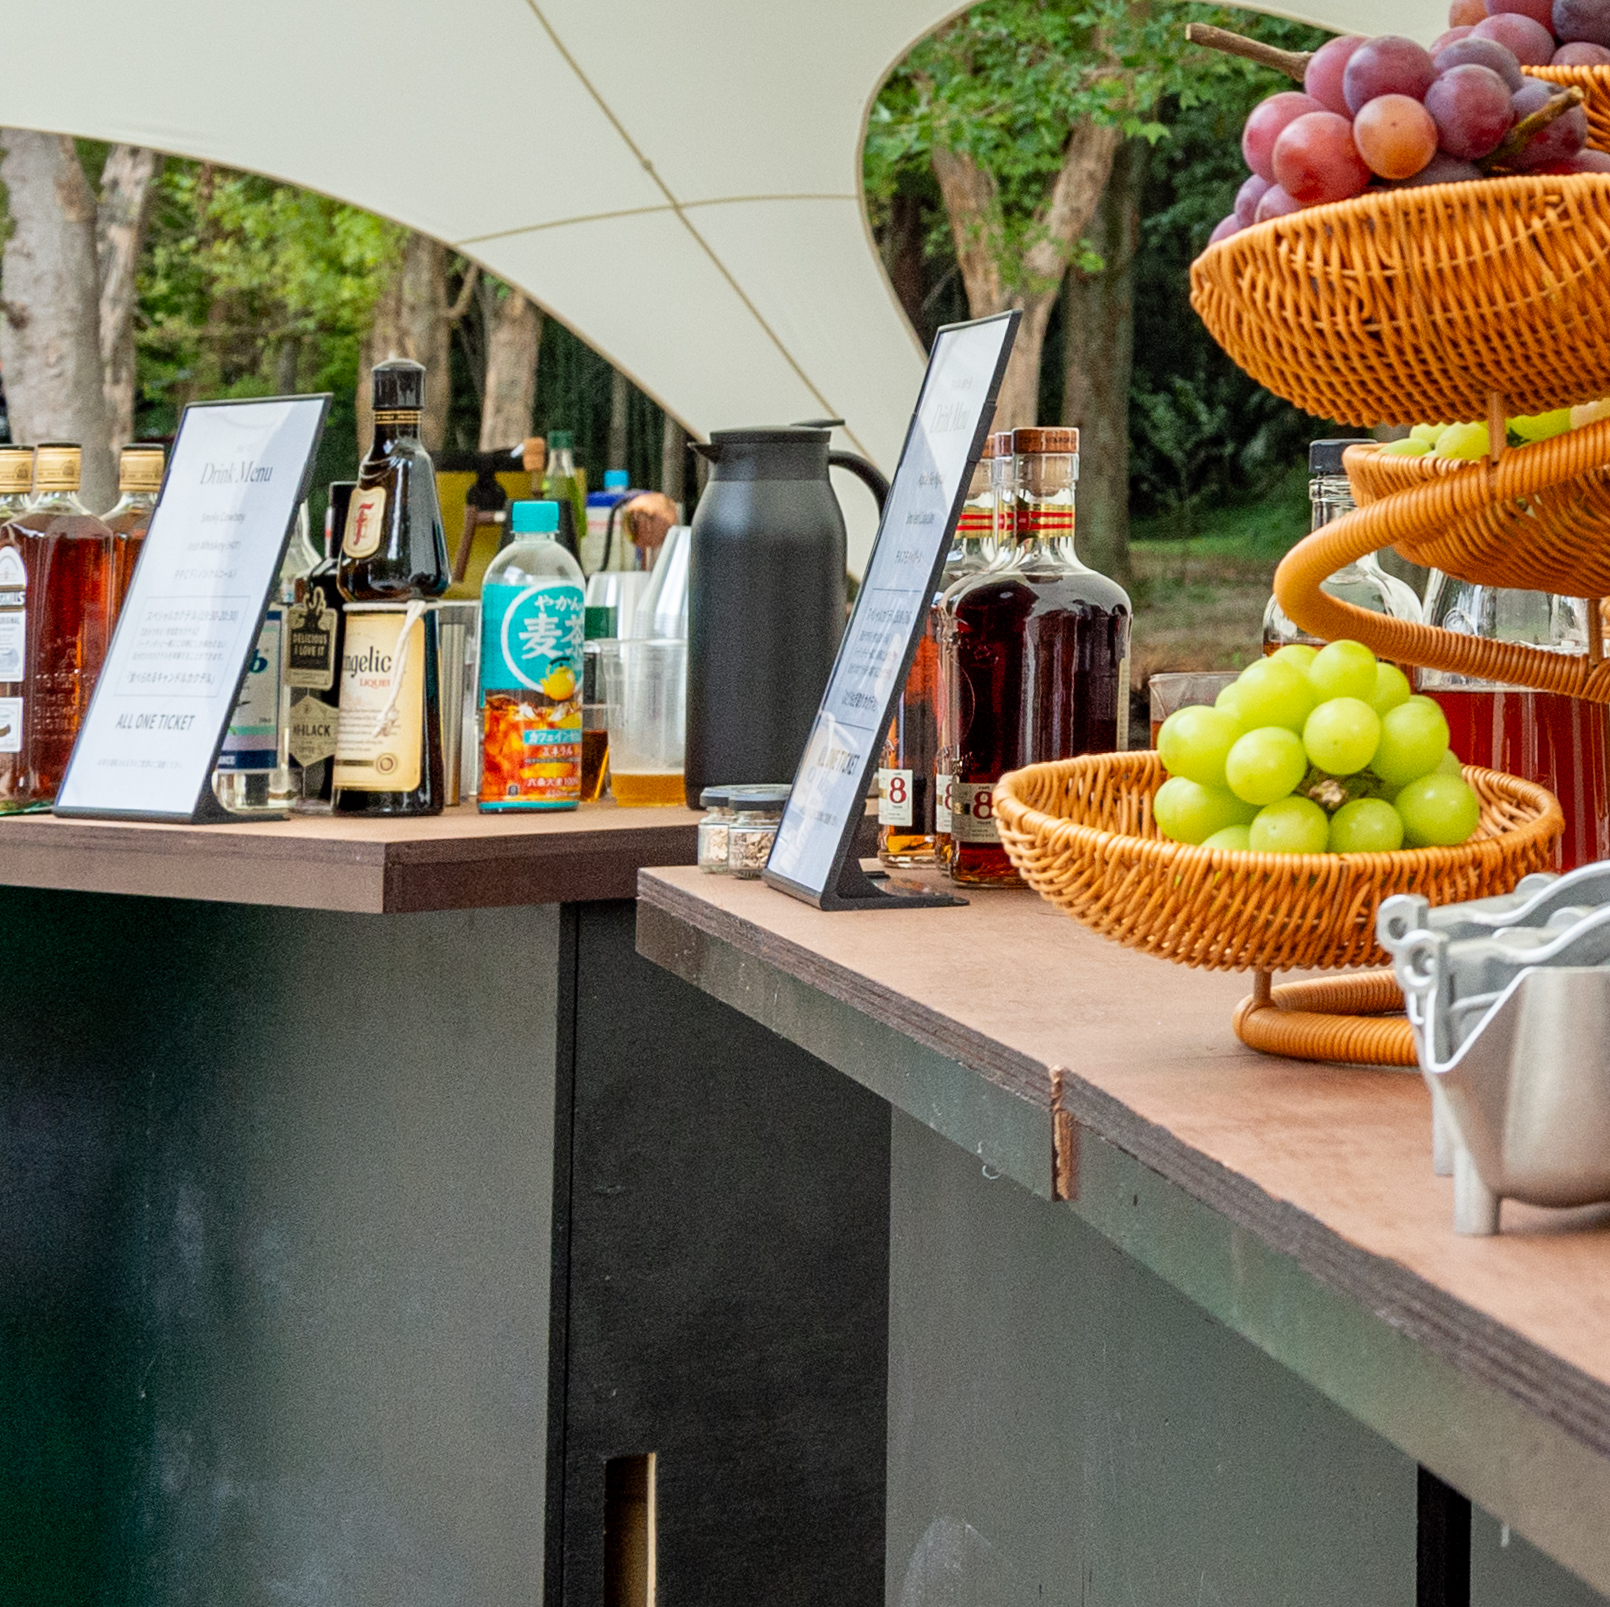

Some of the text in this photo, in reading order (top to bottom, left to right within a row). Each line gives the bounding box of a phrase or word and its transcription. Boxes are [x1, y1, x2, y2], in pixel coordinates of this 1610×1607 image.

[200, 461, 273, 485] Drink Menu
[519, 612, 584, 663] 麦茶
[115, 713, 196, 731] ALL ONE TICKET
[889, 777, 906, 804] 8
[973, 791, 994, 820] 8
